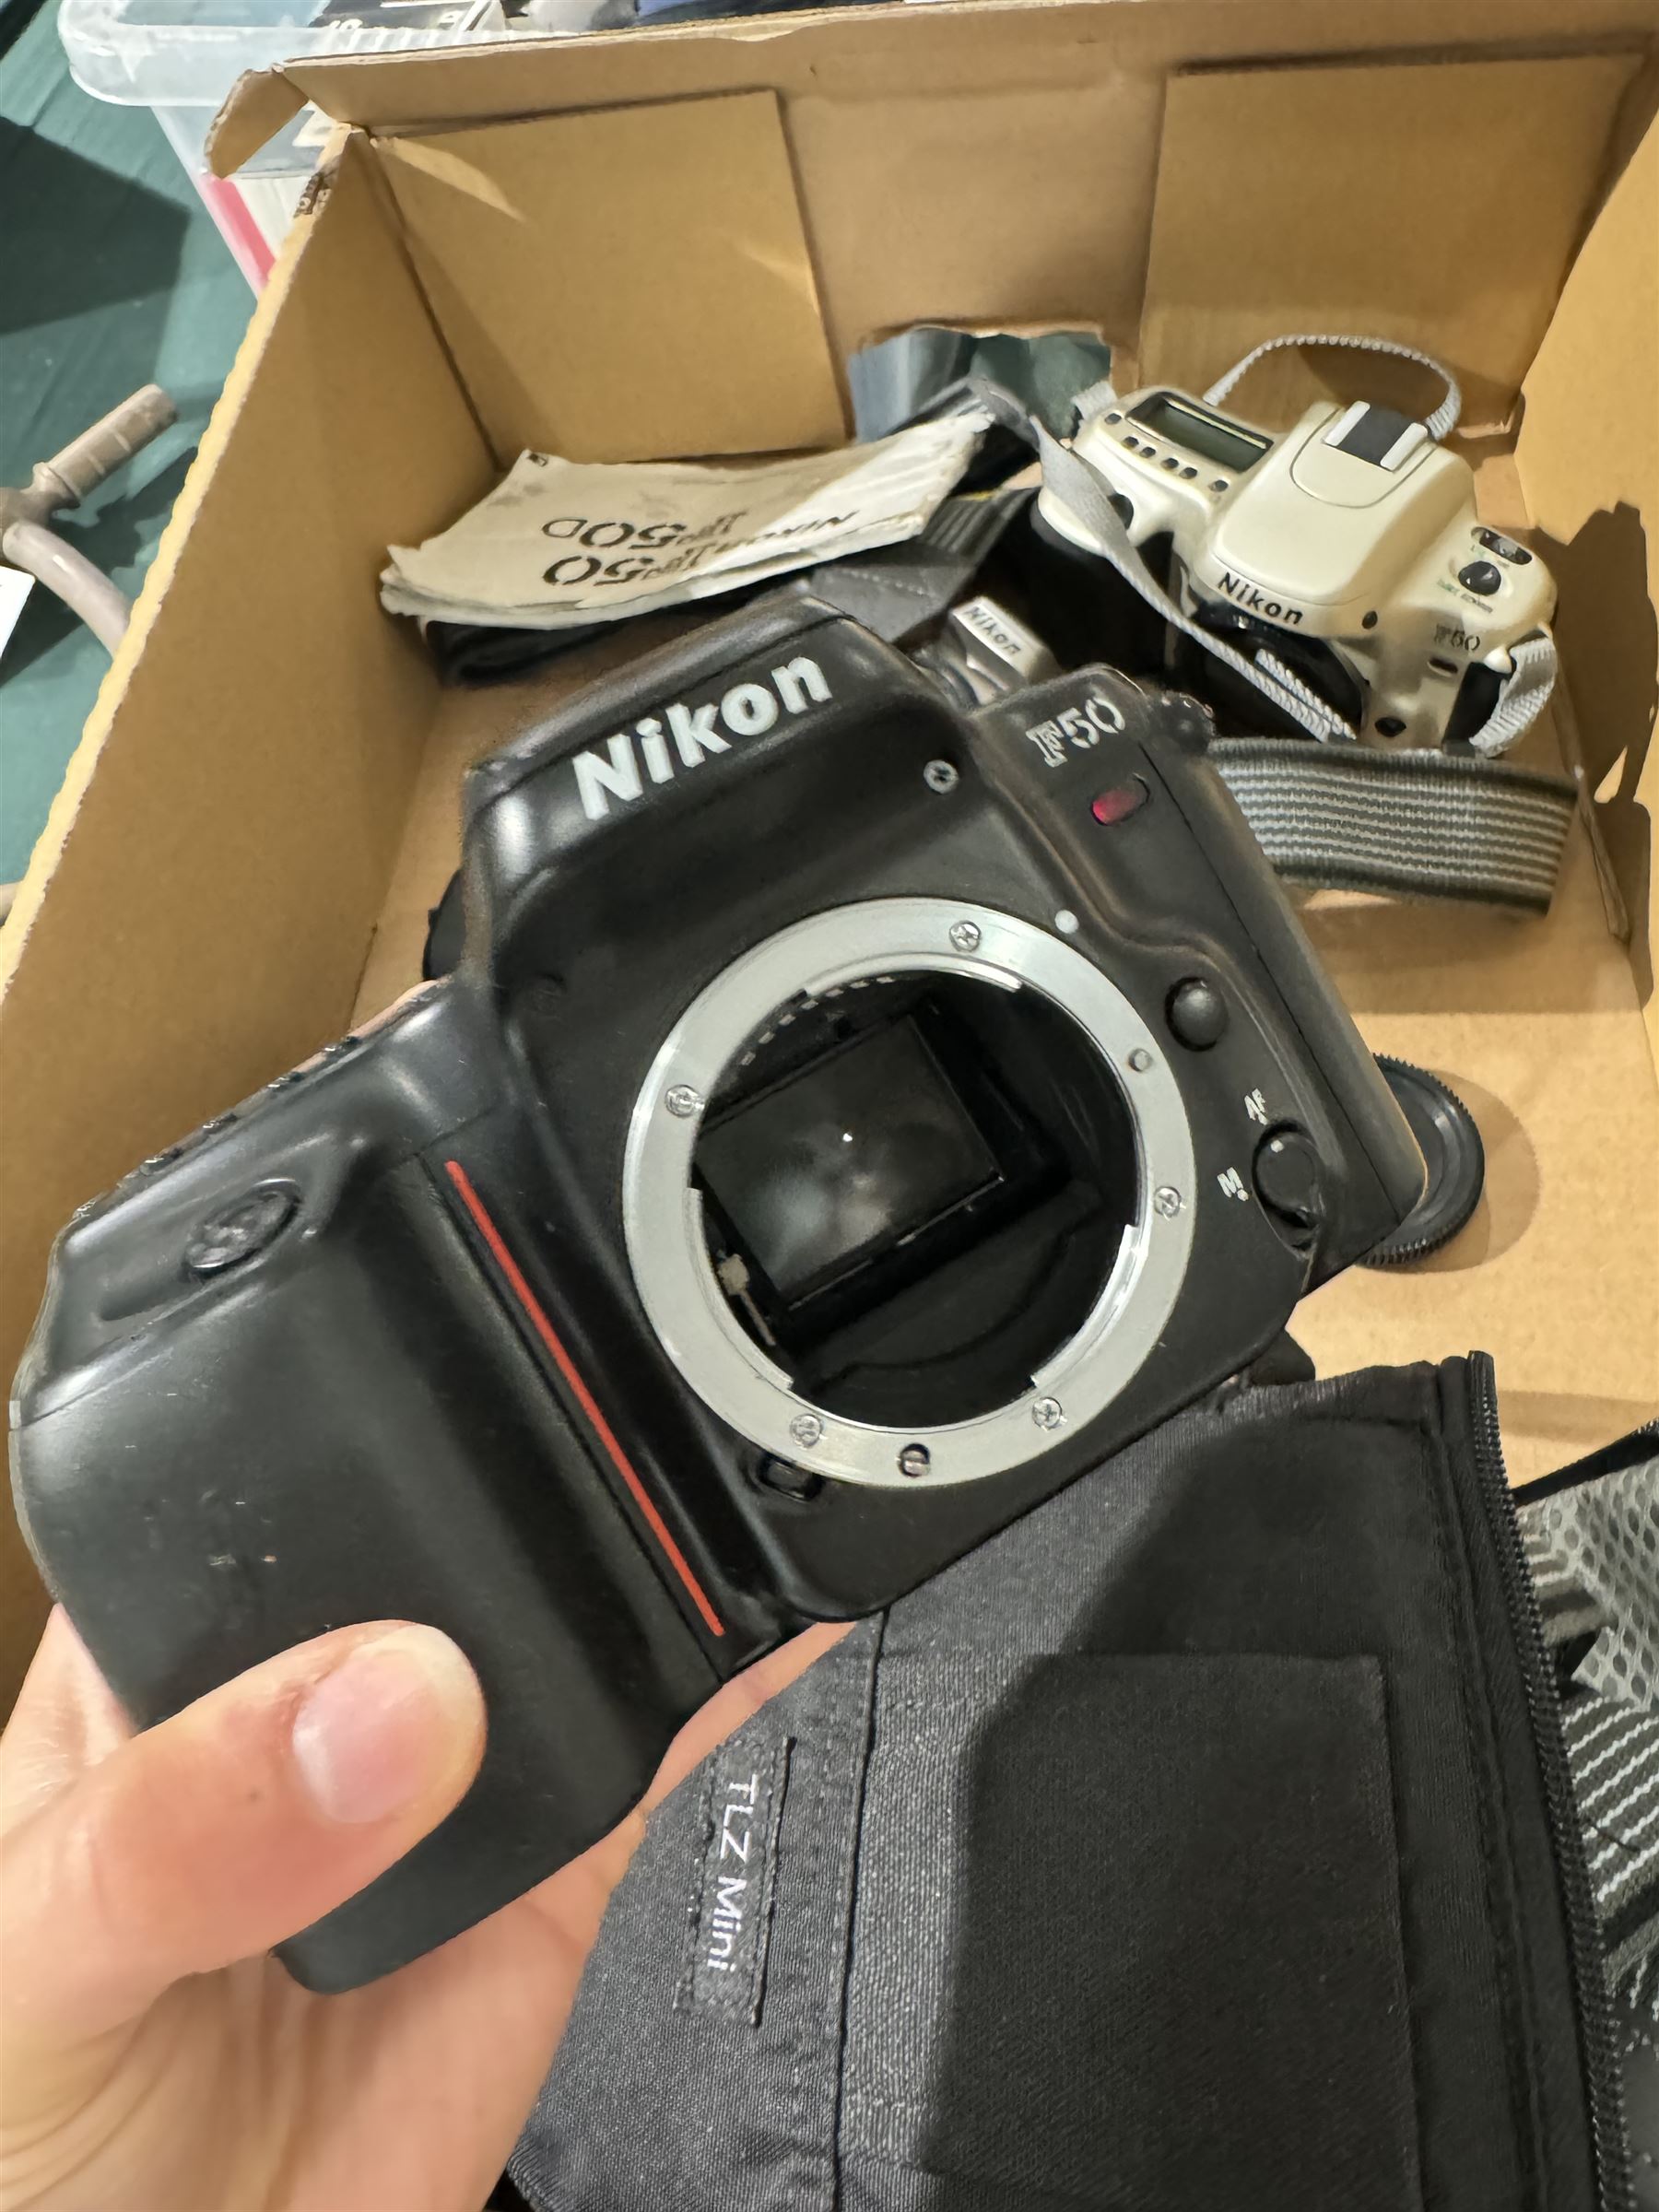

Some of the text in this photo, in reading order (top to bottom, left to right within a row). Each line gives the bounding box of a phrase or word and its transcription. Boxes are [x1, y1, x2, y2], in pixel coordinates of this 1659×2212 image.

[962, 606, 1021, 655] Nikon
[1218, 571, 1303, 625] Nikon
[571, 655, 833, 820] Nikon
[1025, 696, 1125, 768] F50
[706, 1773, 759, 1972] TLZ Mini
